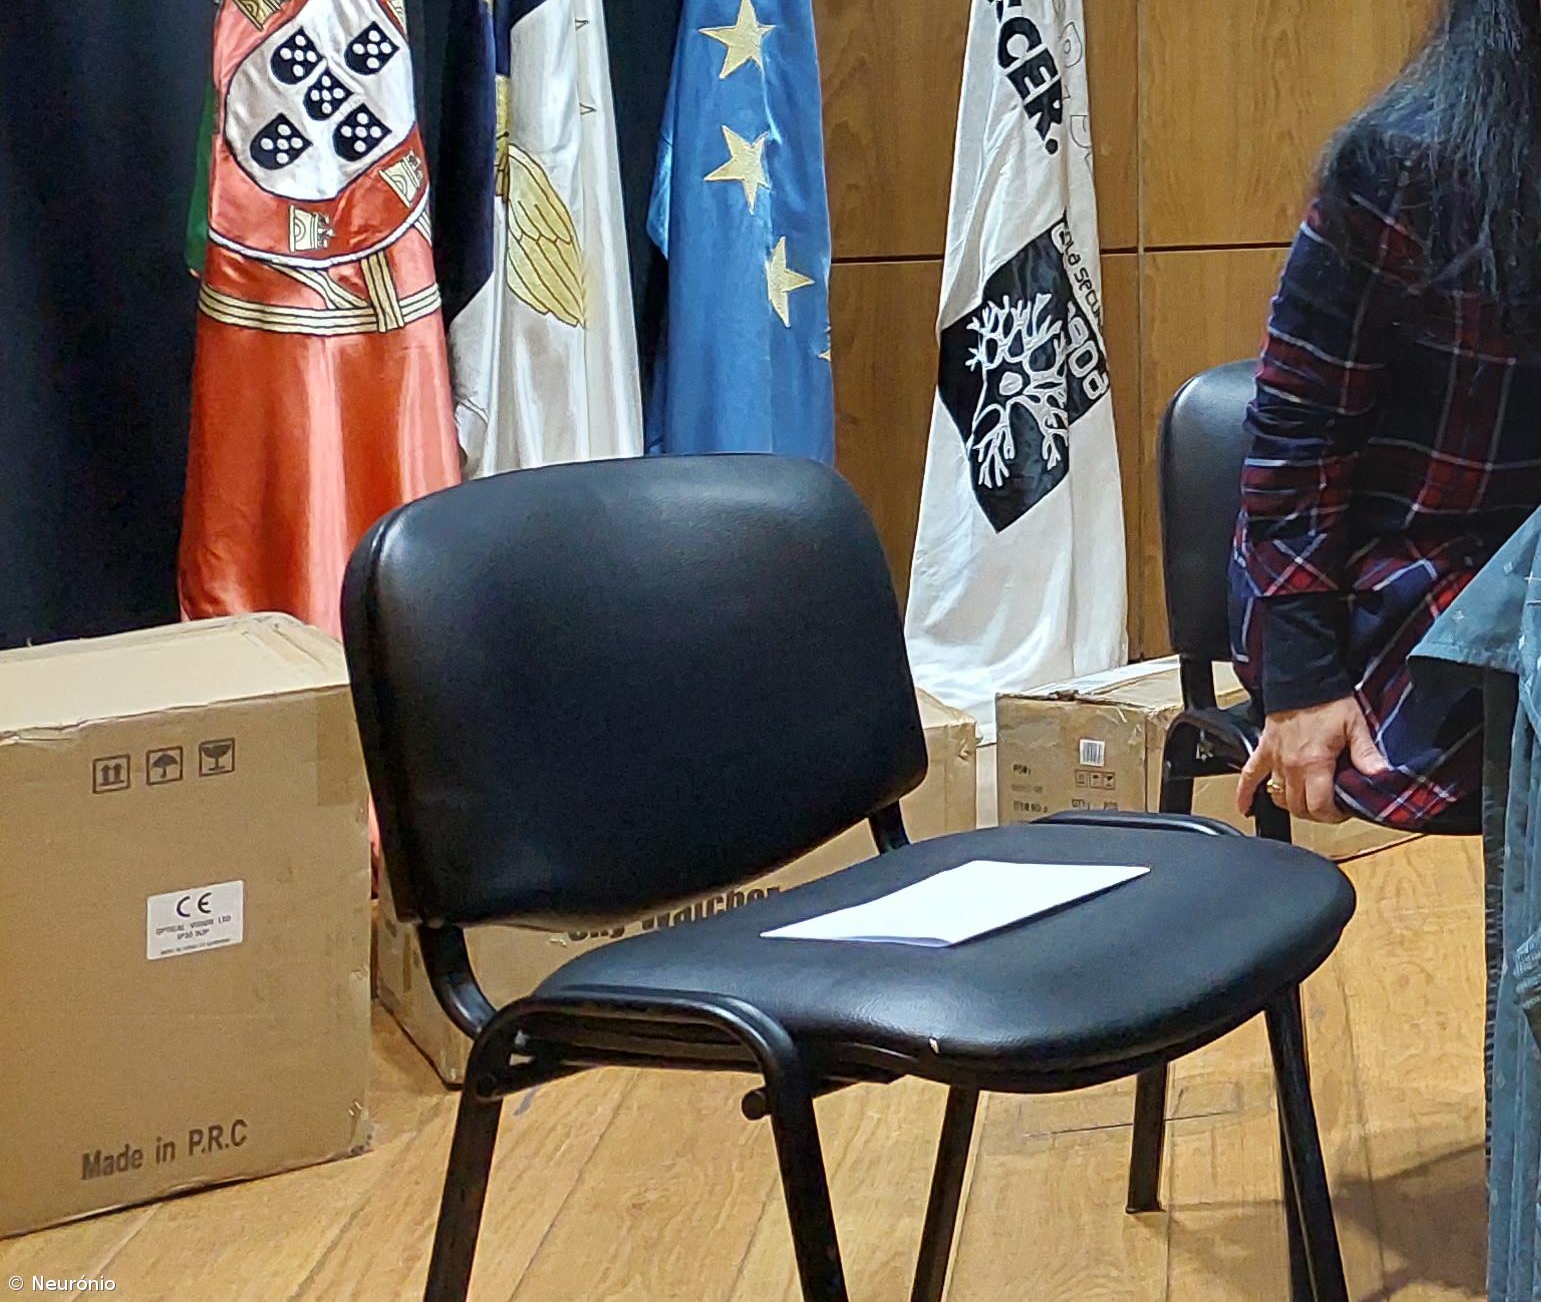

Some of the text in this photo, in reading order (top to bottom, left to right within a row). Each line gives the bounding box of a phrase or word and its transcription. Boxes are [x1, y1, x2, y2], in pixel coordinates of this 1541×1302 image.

[81, 1118, 249, 1181] Made in P.R.C
